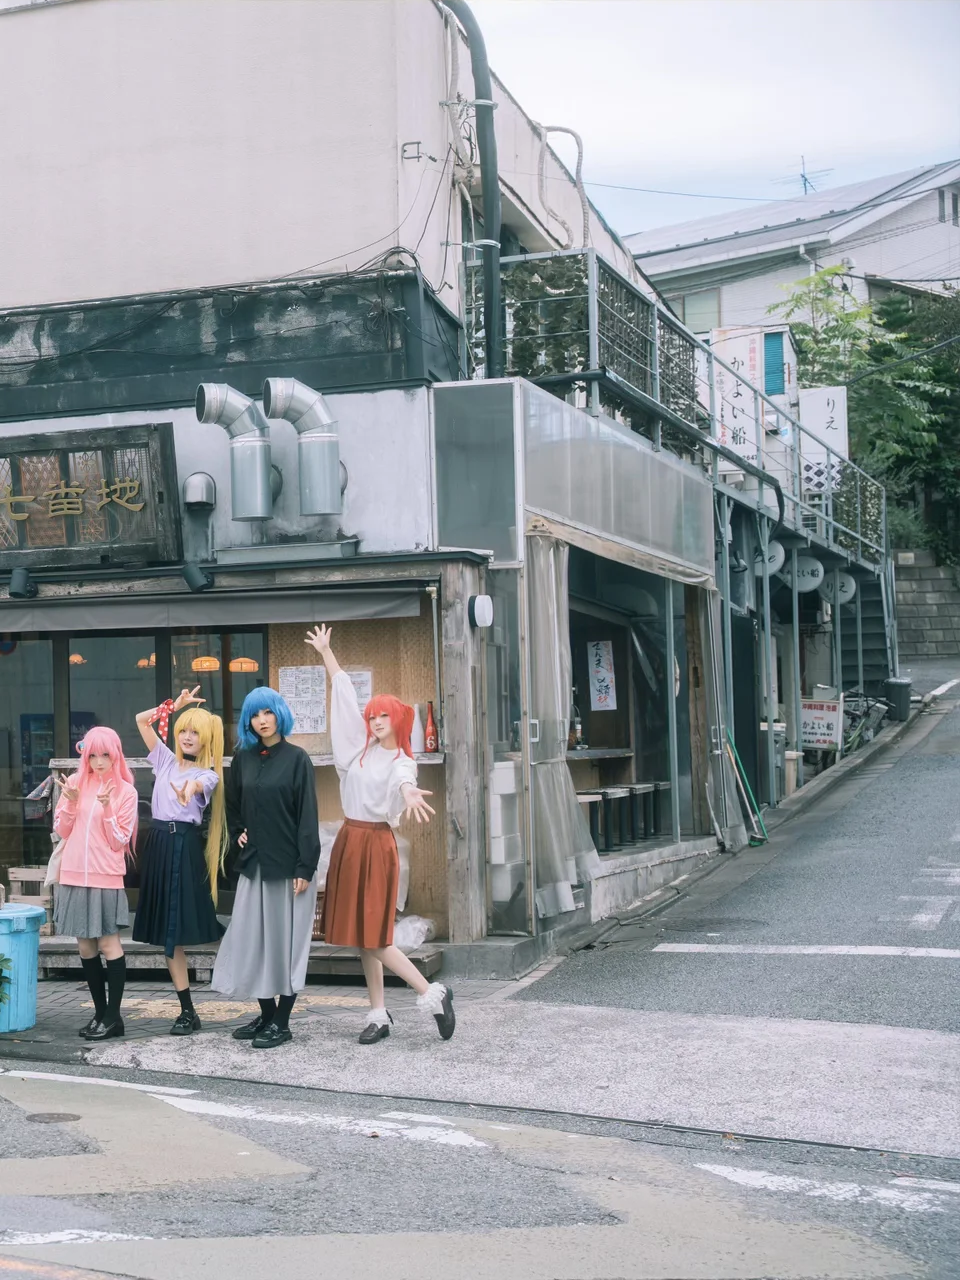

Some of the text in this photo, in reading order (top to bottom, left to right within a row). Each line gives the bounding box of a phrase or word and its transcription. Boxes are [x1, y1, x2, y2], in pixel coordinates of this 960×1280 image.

[731, 357, 747, 445] かよい船
[826, 397, 839, 430] りえ
